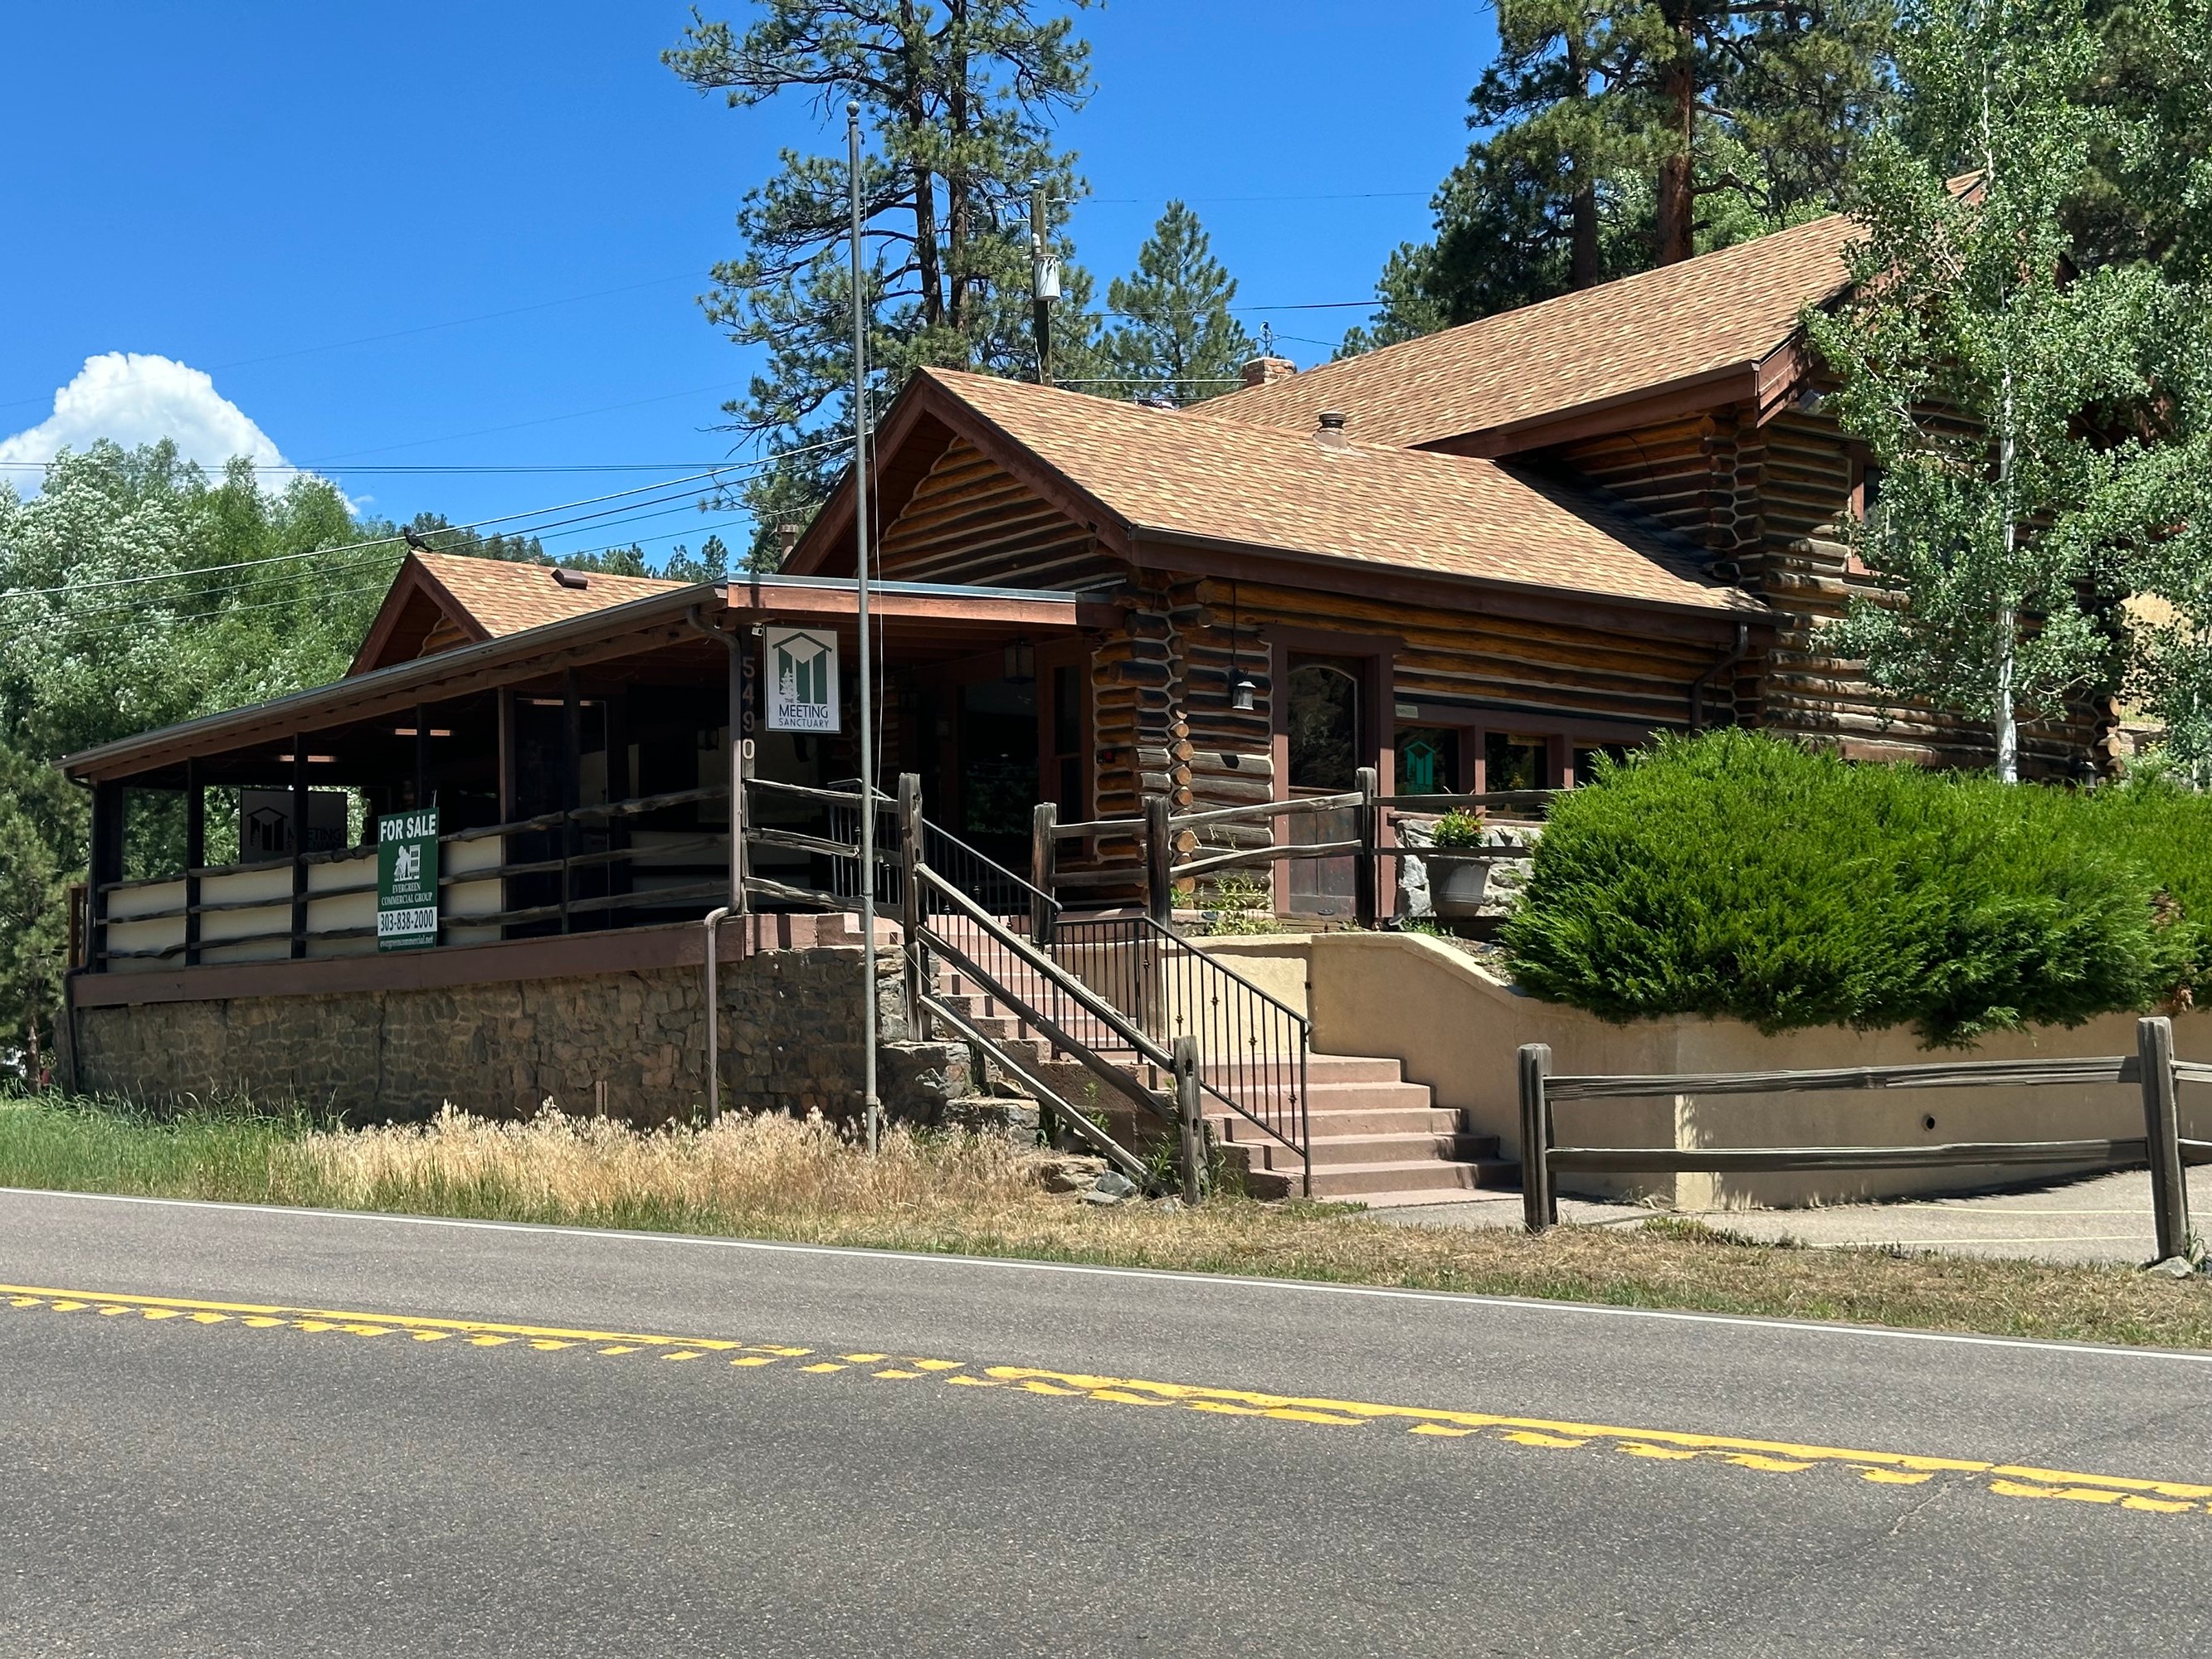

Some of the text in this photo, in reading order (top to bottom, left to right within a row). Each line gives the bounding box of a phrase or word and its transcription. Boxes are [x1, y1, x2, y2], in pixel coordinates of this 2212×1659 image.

[743, 656, 756, 760] 5490
[778, 704, 828, 718] MEETING
[778, 718, 830, 728] SANCTUARY
[287, 827, 342, 841] METING
[380, 814, 436, 842] FOR SALE
[392, 882, 421, 894] EVERGREEN
[381, 892, 433, 906] COMMERCIAL GROUP
[380, 909, 434, 932] 303-838-2000
